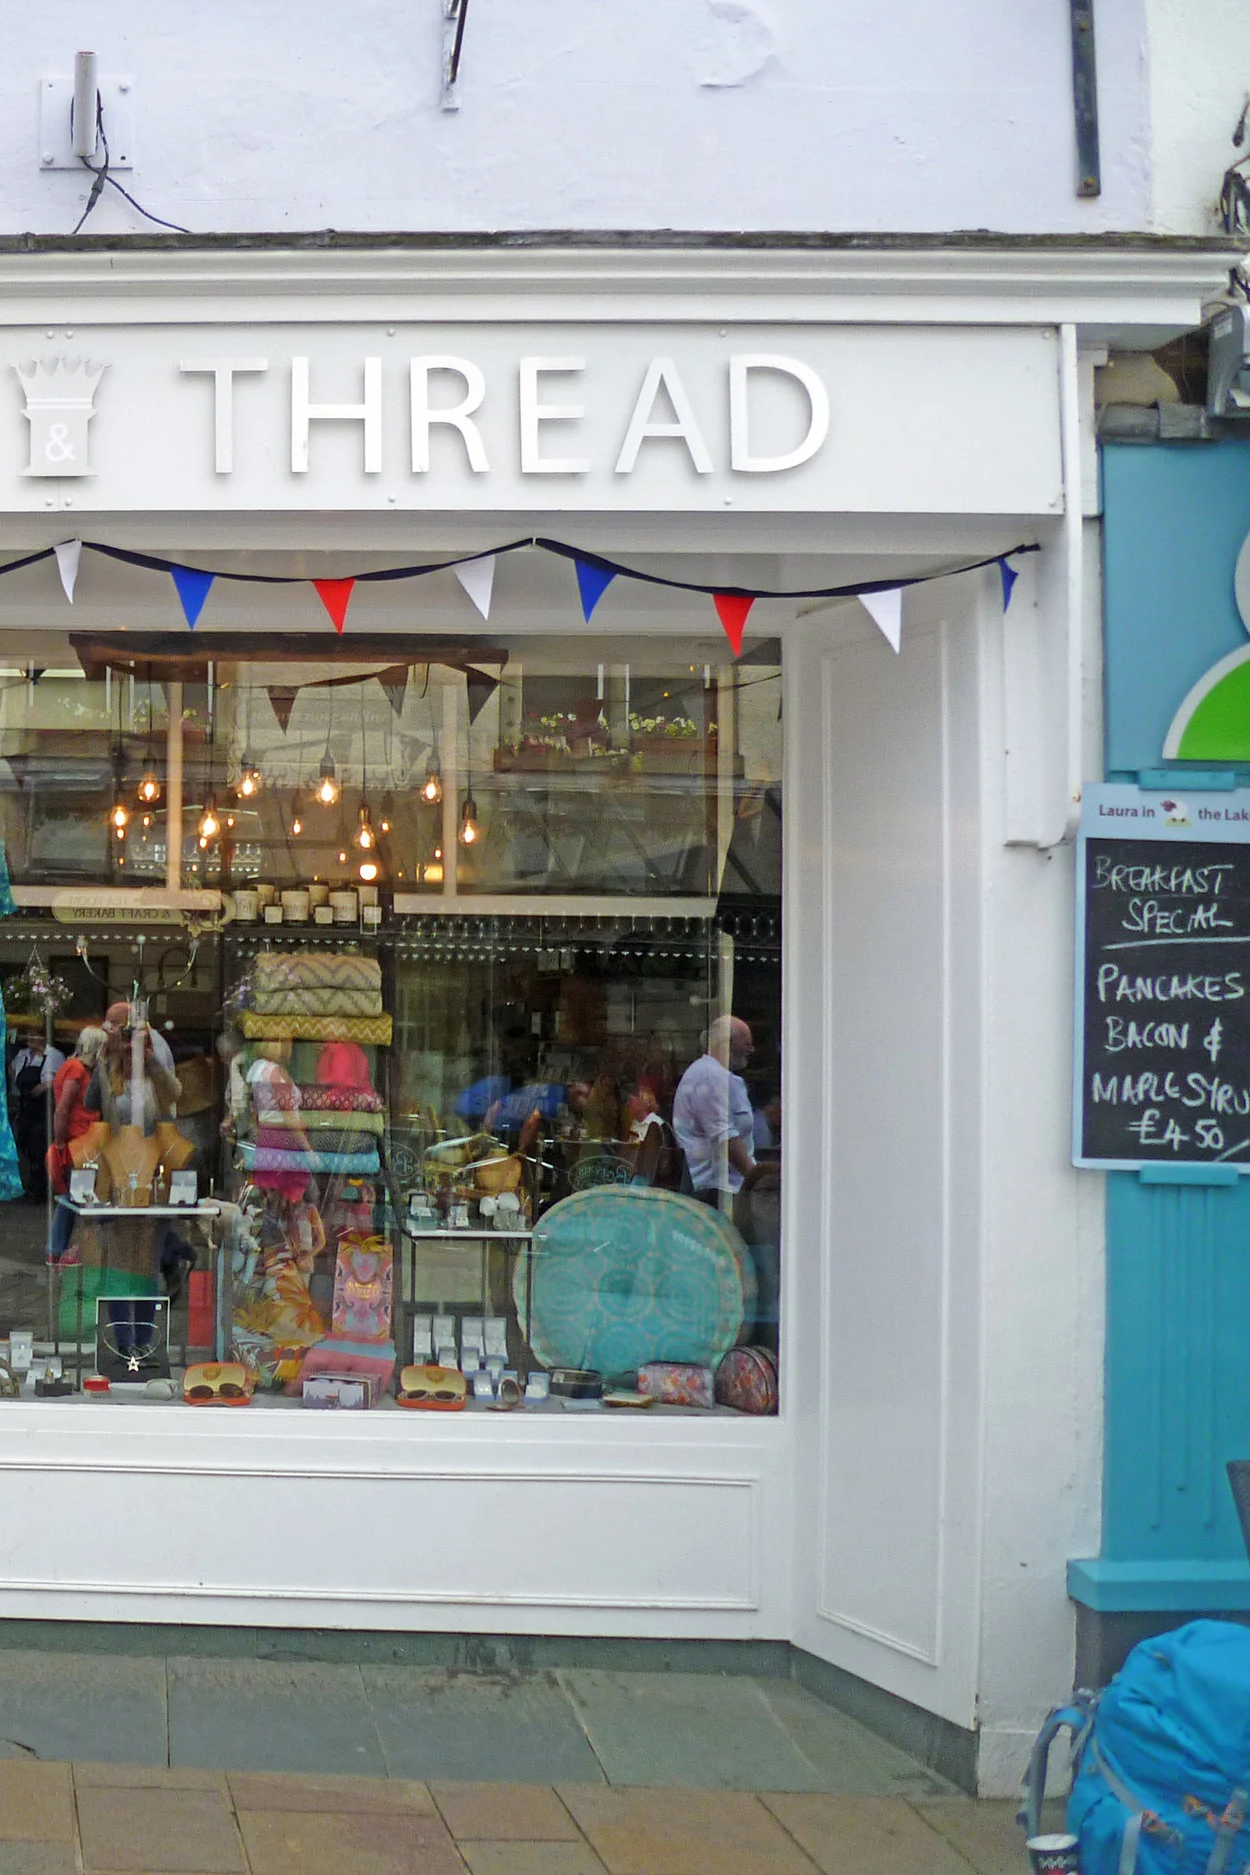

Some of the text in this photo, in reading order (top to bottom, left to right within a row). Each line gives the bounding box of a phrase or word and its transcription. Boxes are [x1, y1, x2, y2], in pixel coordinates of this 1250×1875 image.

[44, 422, 77, 461] &
[180, 353, 831, 475] THREAD
[1099, 804, 1250, 822] Laura in the Lak
[1092, 856, 1234, 894] BREAKFAST
[1122, 898, 1234, 933] SPECIAL
[1098, 963, 1244, 1003] PANCAKES
[1105, 1016, 1190, 1051] BACON
[1092, 1072, 1181, 1105] MAPLE
